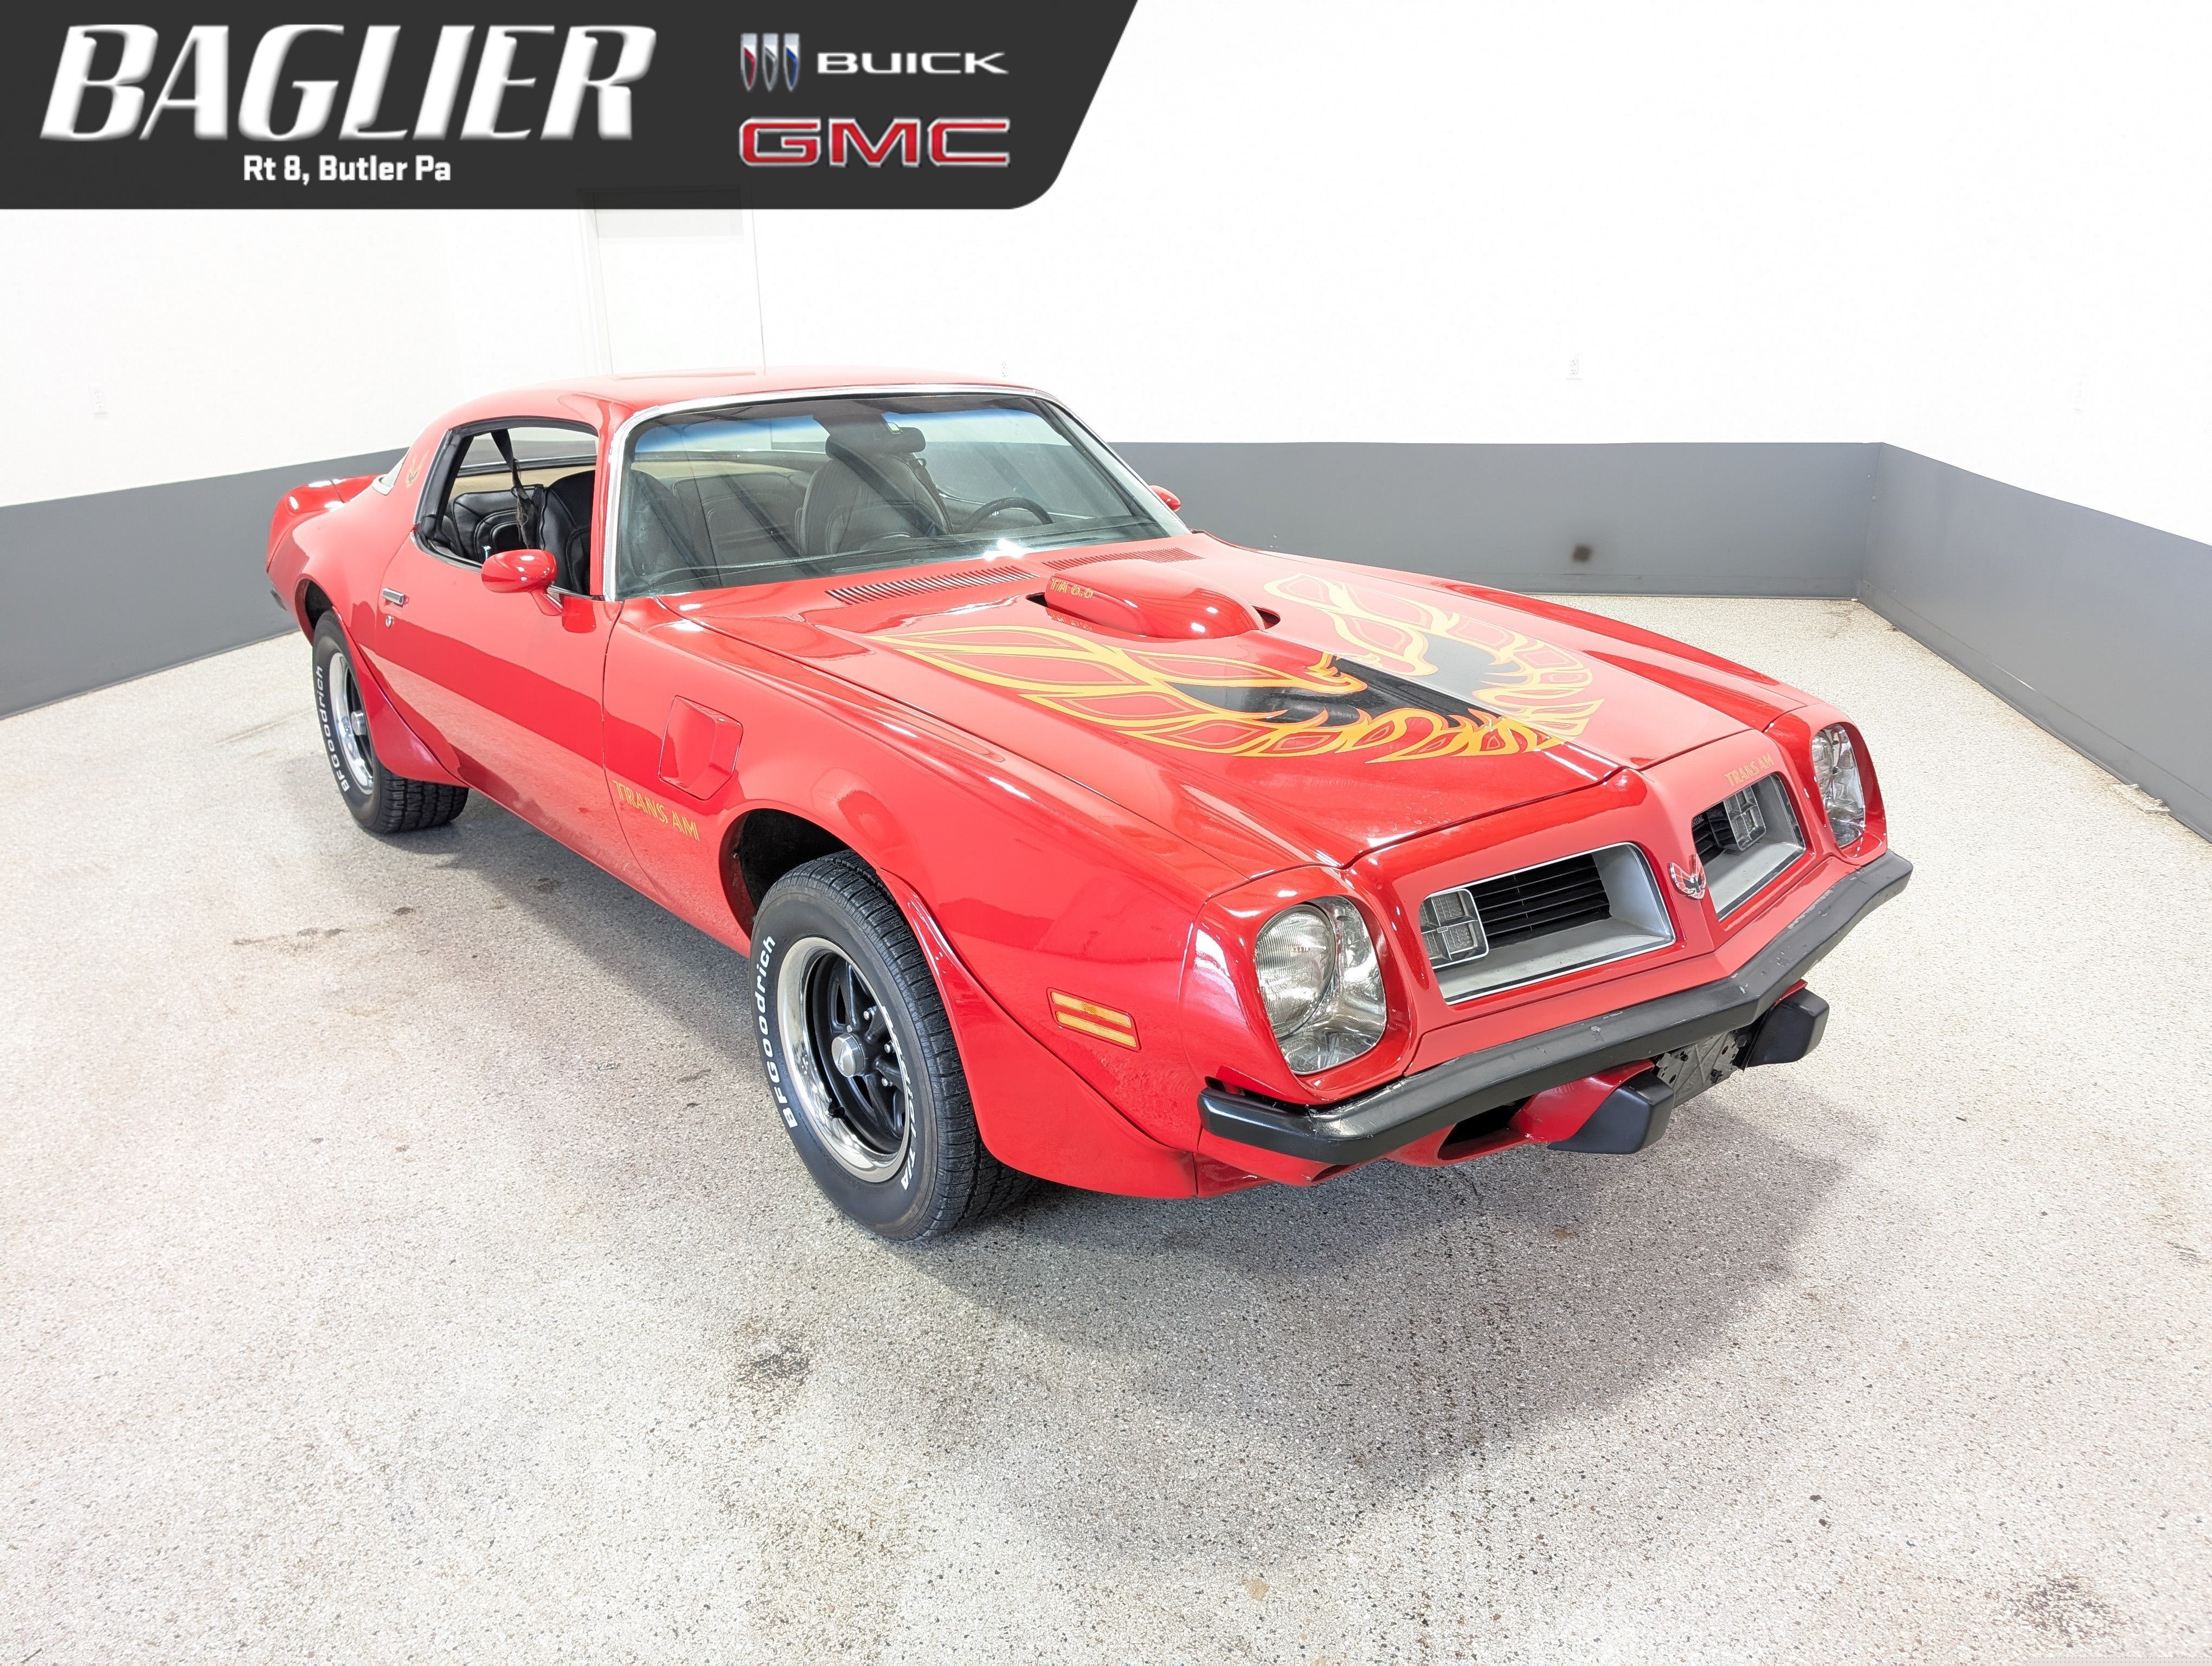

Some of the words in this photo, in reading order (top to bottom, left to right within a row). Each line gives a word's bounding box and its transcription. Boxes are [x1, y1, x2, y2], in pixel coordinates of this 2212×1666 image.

[1070, 584, 1094, 599] 6.6
[315, 665, 350, 792] BFGoodrich
[1723, 760, 1760, 787] TRANS
[1757, 753, 1776, 771] AM
[612, 779, 668, 824] TRANS
[671, 810, 700, 842] AM
[753, 935, 798, 1128] BFGoodrich
